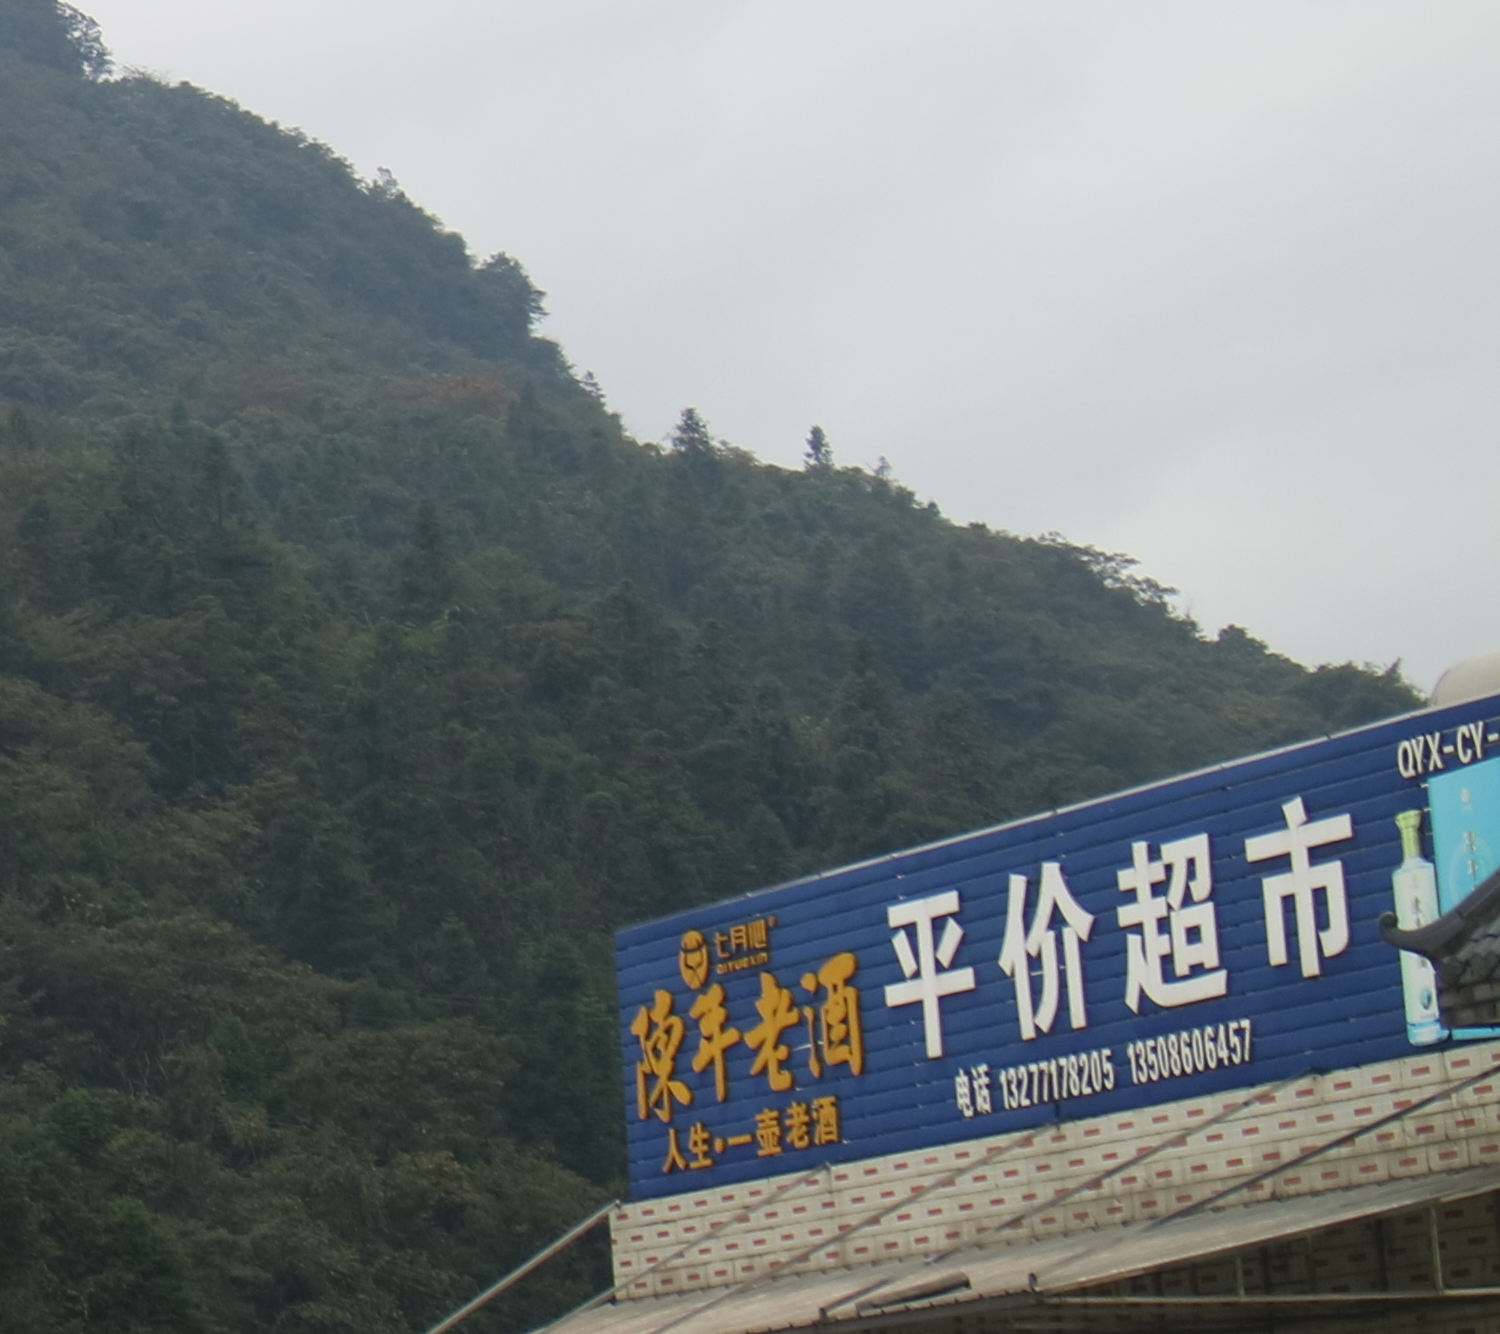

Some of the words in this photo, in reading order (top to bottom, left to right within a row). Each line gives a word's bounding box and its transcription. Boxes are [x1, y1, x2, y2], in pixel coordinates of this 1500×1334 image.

[884, 797, 1355, 1059] 平价超市
[954, 1063, 992, 1118] 电话
[1000, 1048, 1115, 1110] 13277178205
[1126, 1019, 1251, 1085] 13508606457
